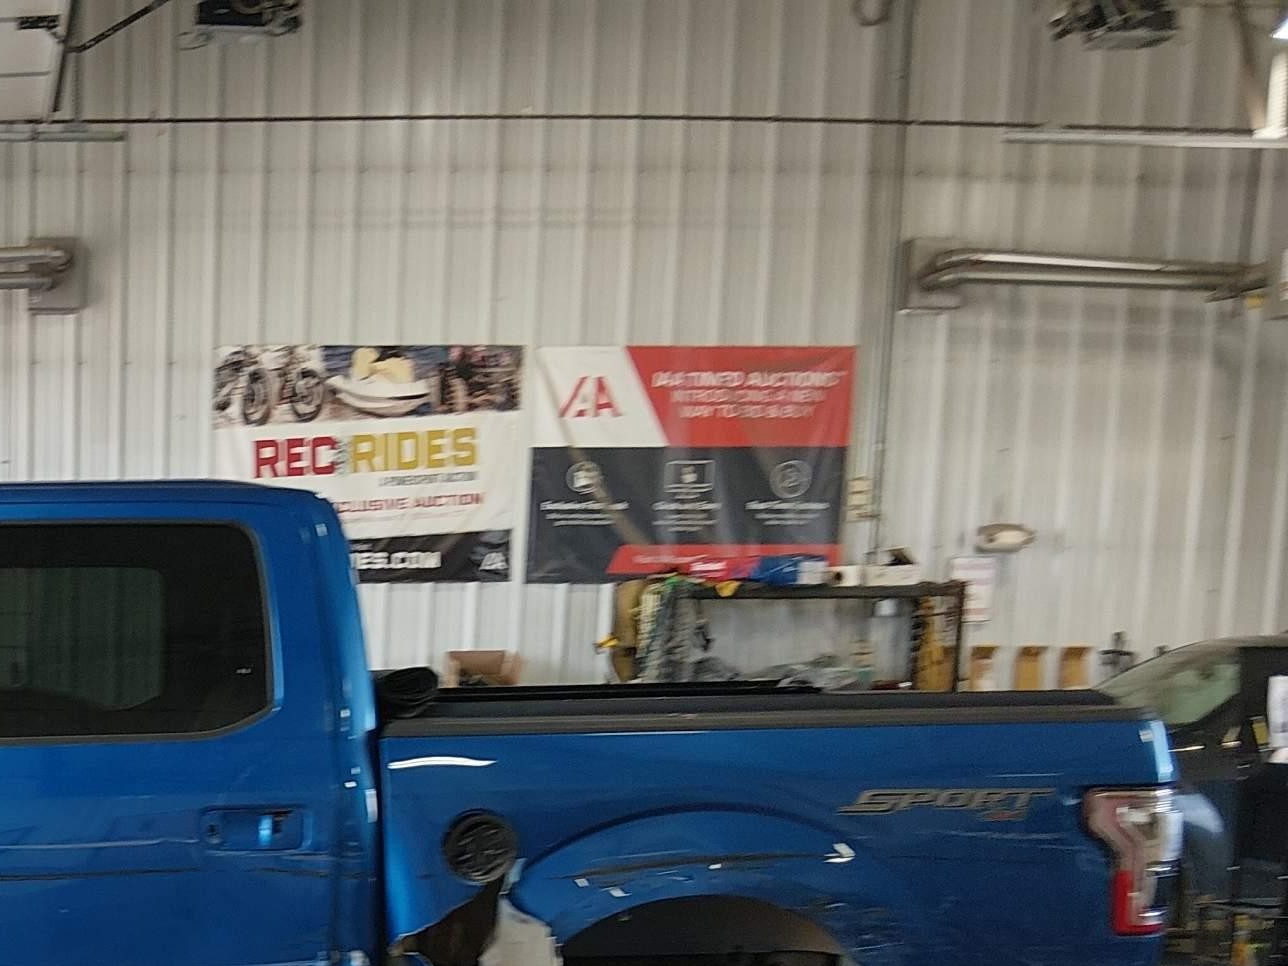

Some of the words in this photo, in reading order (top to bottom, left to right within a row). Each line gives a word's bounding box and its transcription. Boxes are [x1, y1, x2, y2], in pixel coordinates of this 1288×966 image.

[253, 436, 339, 478] REC
[349, 427, 478, 474] RIDES
[334, 497, 408, 514] CLUSIVE
[413, 493, 485, 509] AUCTION
[835, 787, 1057, 815] SPORT
